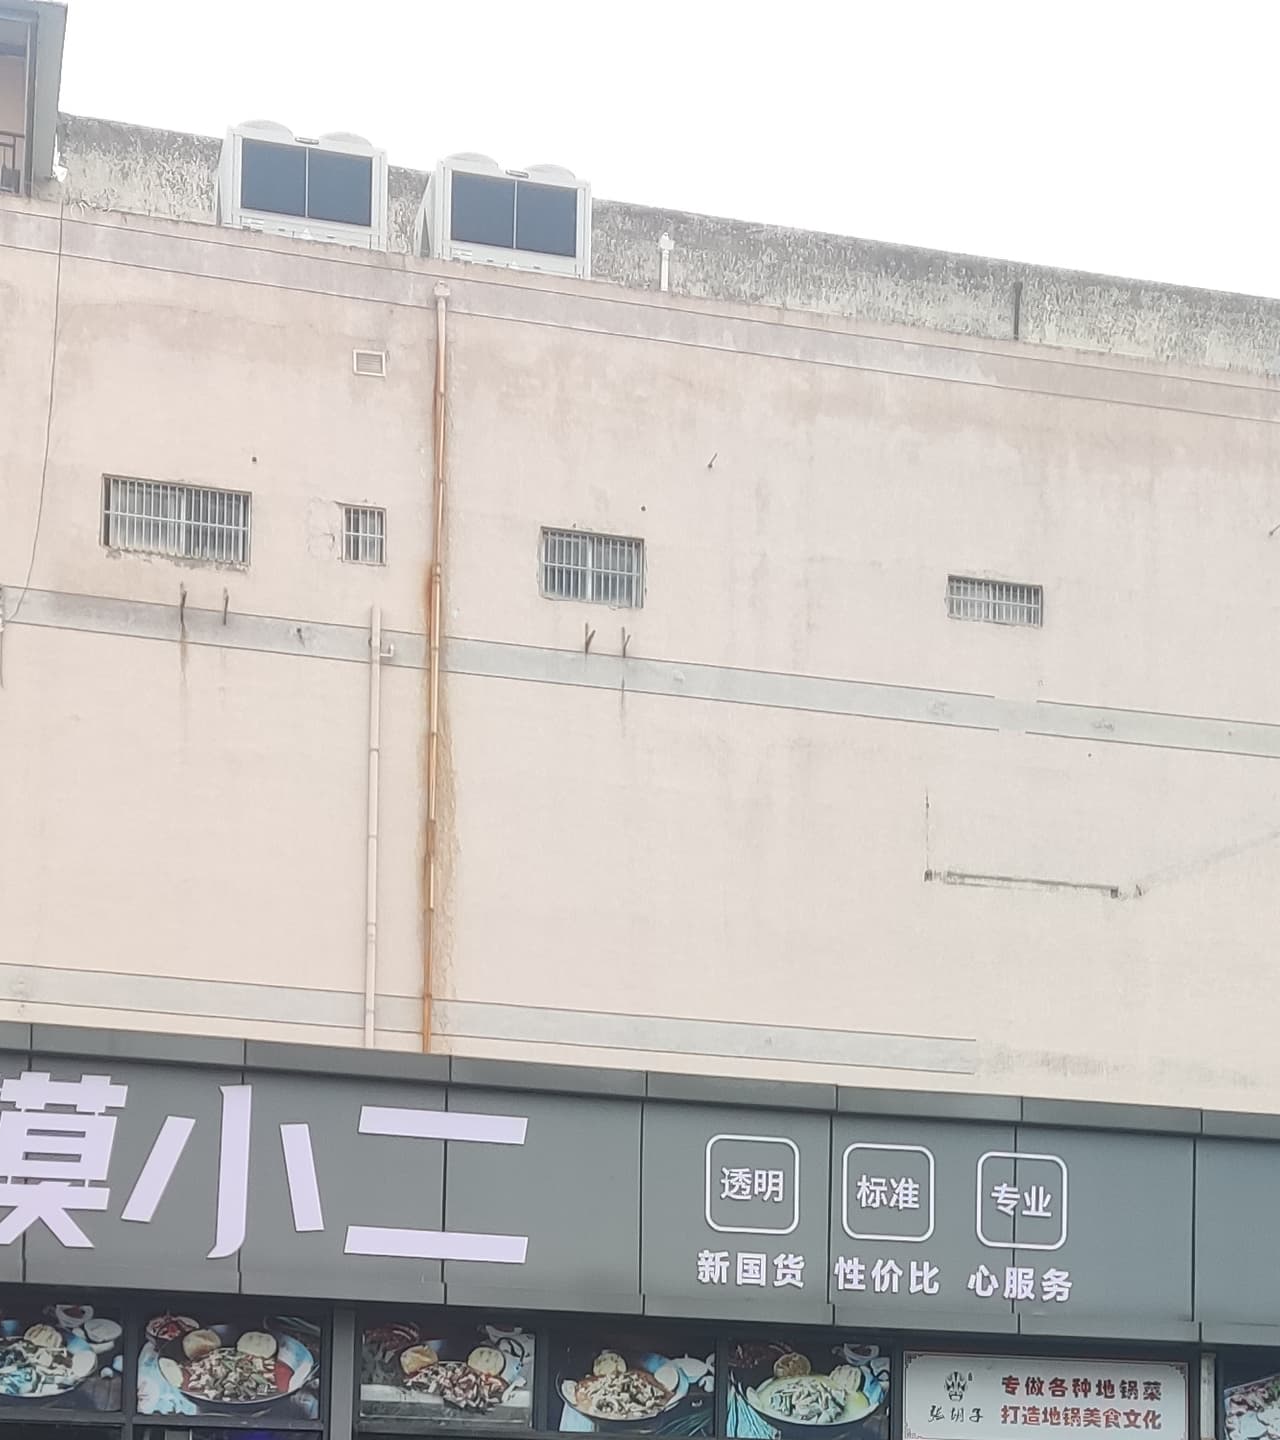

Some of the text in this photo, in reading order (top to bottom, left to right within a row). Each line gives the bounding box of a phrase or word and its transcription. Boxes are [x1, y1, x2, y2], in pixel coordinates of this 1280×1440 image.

[719, 1166, 785, 1202] 透明
[856, 1174, 920, 1211] 标准
[990, 1182, 1053, 1218] 专业
[696, 1249, 1073, 1302] 新国货 性价比 心服务
[1001, 1375, 1162, 1402] 专做各种地锅菜
[1000, 1404, 1162, 1430] 打造地锅美食文化
